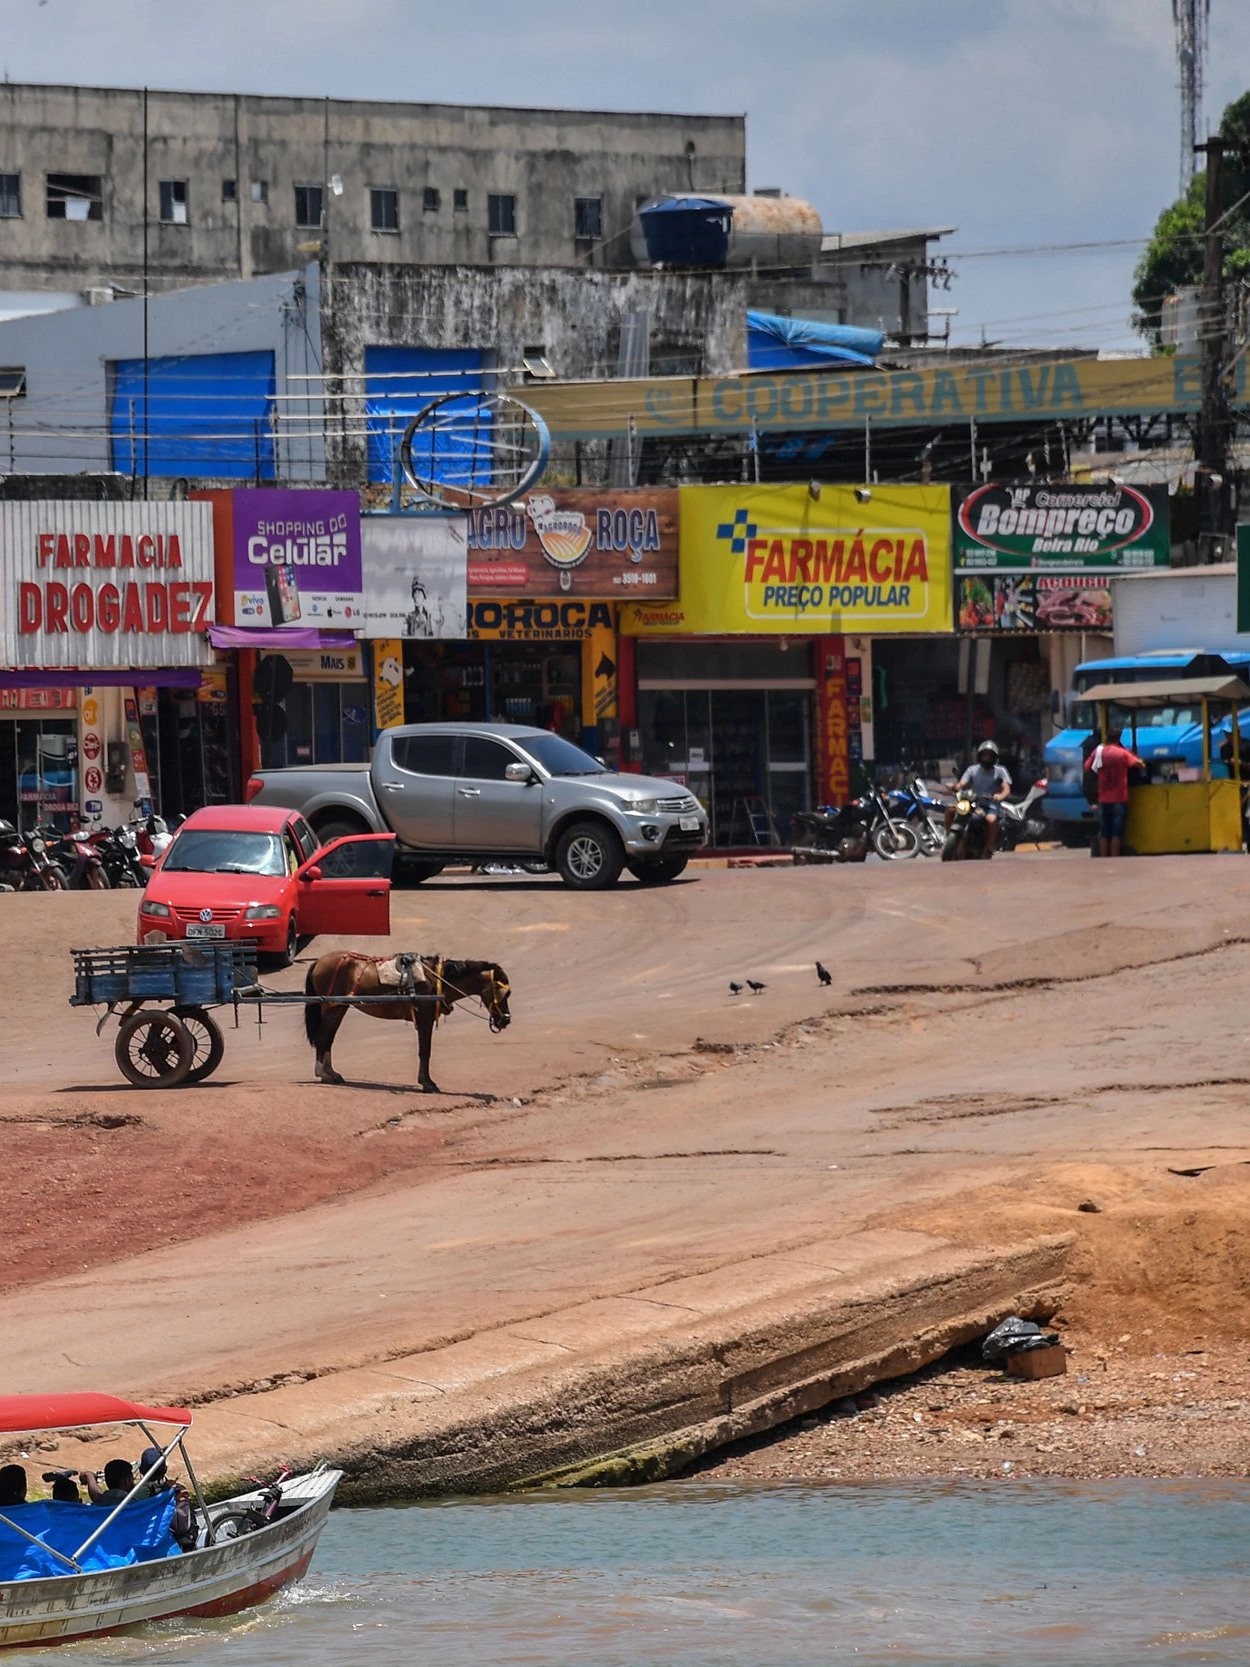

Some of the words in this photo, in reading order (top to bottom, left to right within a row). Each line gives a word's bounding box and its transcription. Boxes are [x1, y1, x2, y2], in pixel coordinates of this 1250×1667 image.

[712, 363, 1083, 422] COOPERATIVA
[258, 521, 324, 536] SHOPPING
[330, 513, 347, 533] DO
[596, 508, 660, 562] ROÇA
[976, 503, 1136, 540] Bompreço
[38, 533, 183, 569] FARMACIA
[248, 535, 347, 566] Celular
[744, 528, 929, 584] FARMÁCIA
[1031, 537, 1073, 553] Beira
[1075, 537, 1099, 553] Rio
[19, 582, 214, 634] DROGADEZ
[763, 585, 824, 613] PREÇO
[829, 585, 911, 608] POPULAR
